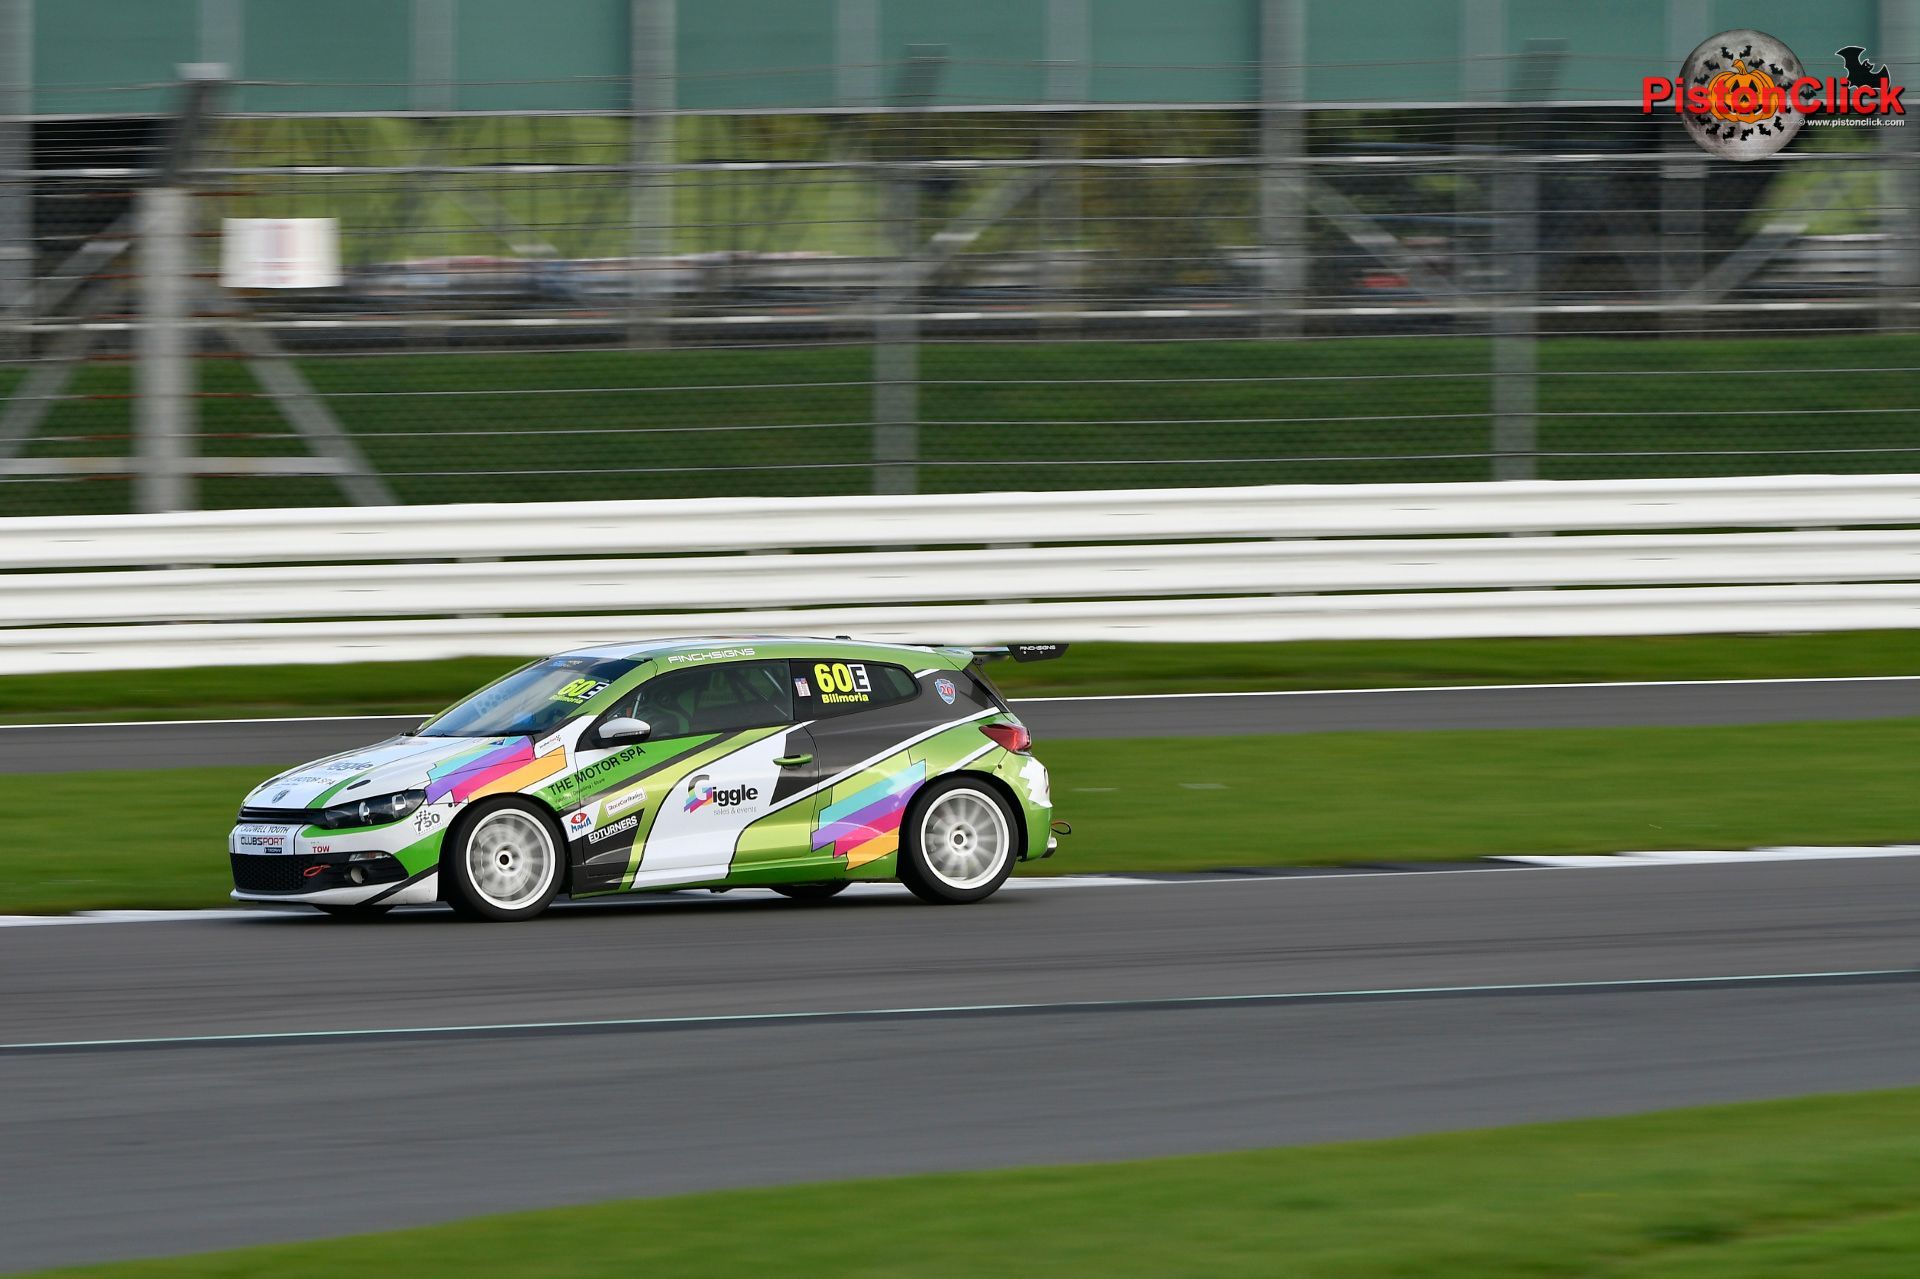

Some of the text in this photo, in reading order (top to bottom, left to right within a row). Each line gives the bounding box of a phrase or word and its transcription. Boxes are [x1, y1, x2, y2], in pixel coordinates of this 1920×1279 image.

[668, 648, 755, 664] FINCHSIGNS
[821, 693, 869, 704] Bilimoria
[548, 777, 573, 796] THE
[574, 758, 620, 783] MOTOR
[619, 745, 646, 762] SPA
[267, 826, 291, 834] YOUTH
[414, 813, 441, 832] 750
[588, 815, 638, 843] EDTURNERS
[240, 837, 285, 846] CLUBSPORT
